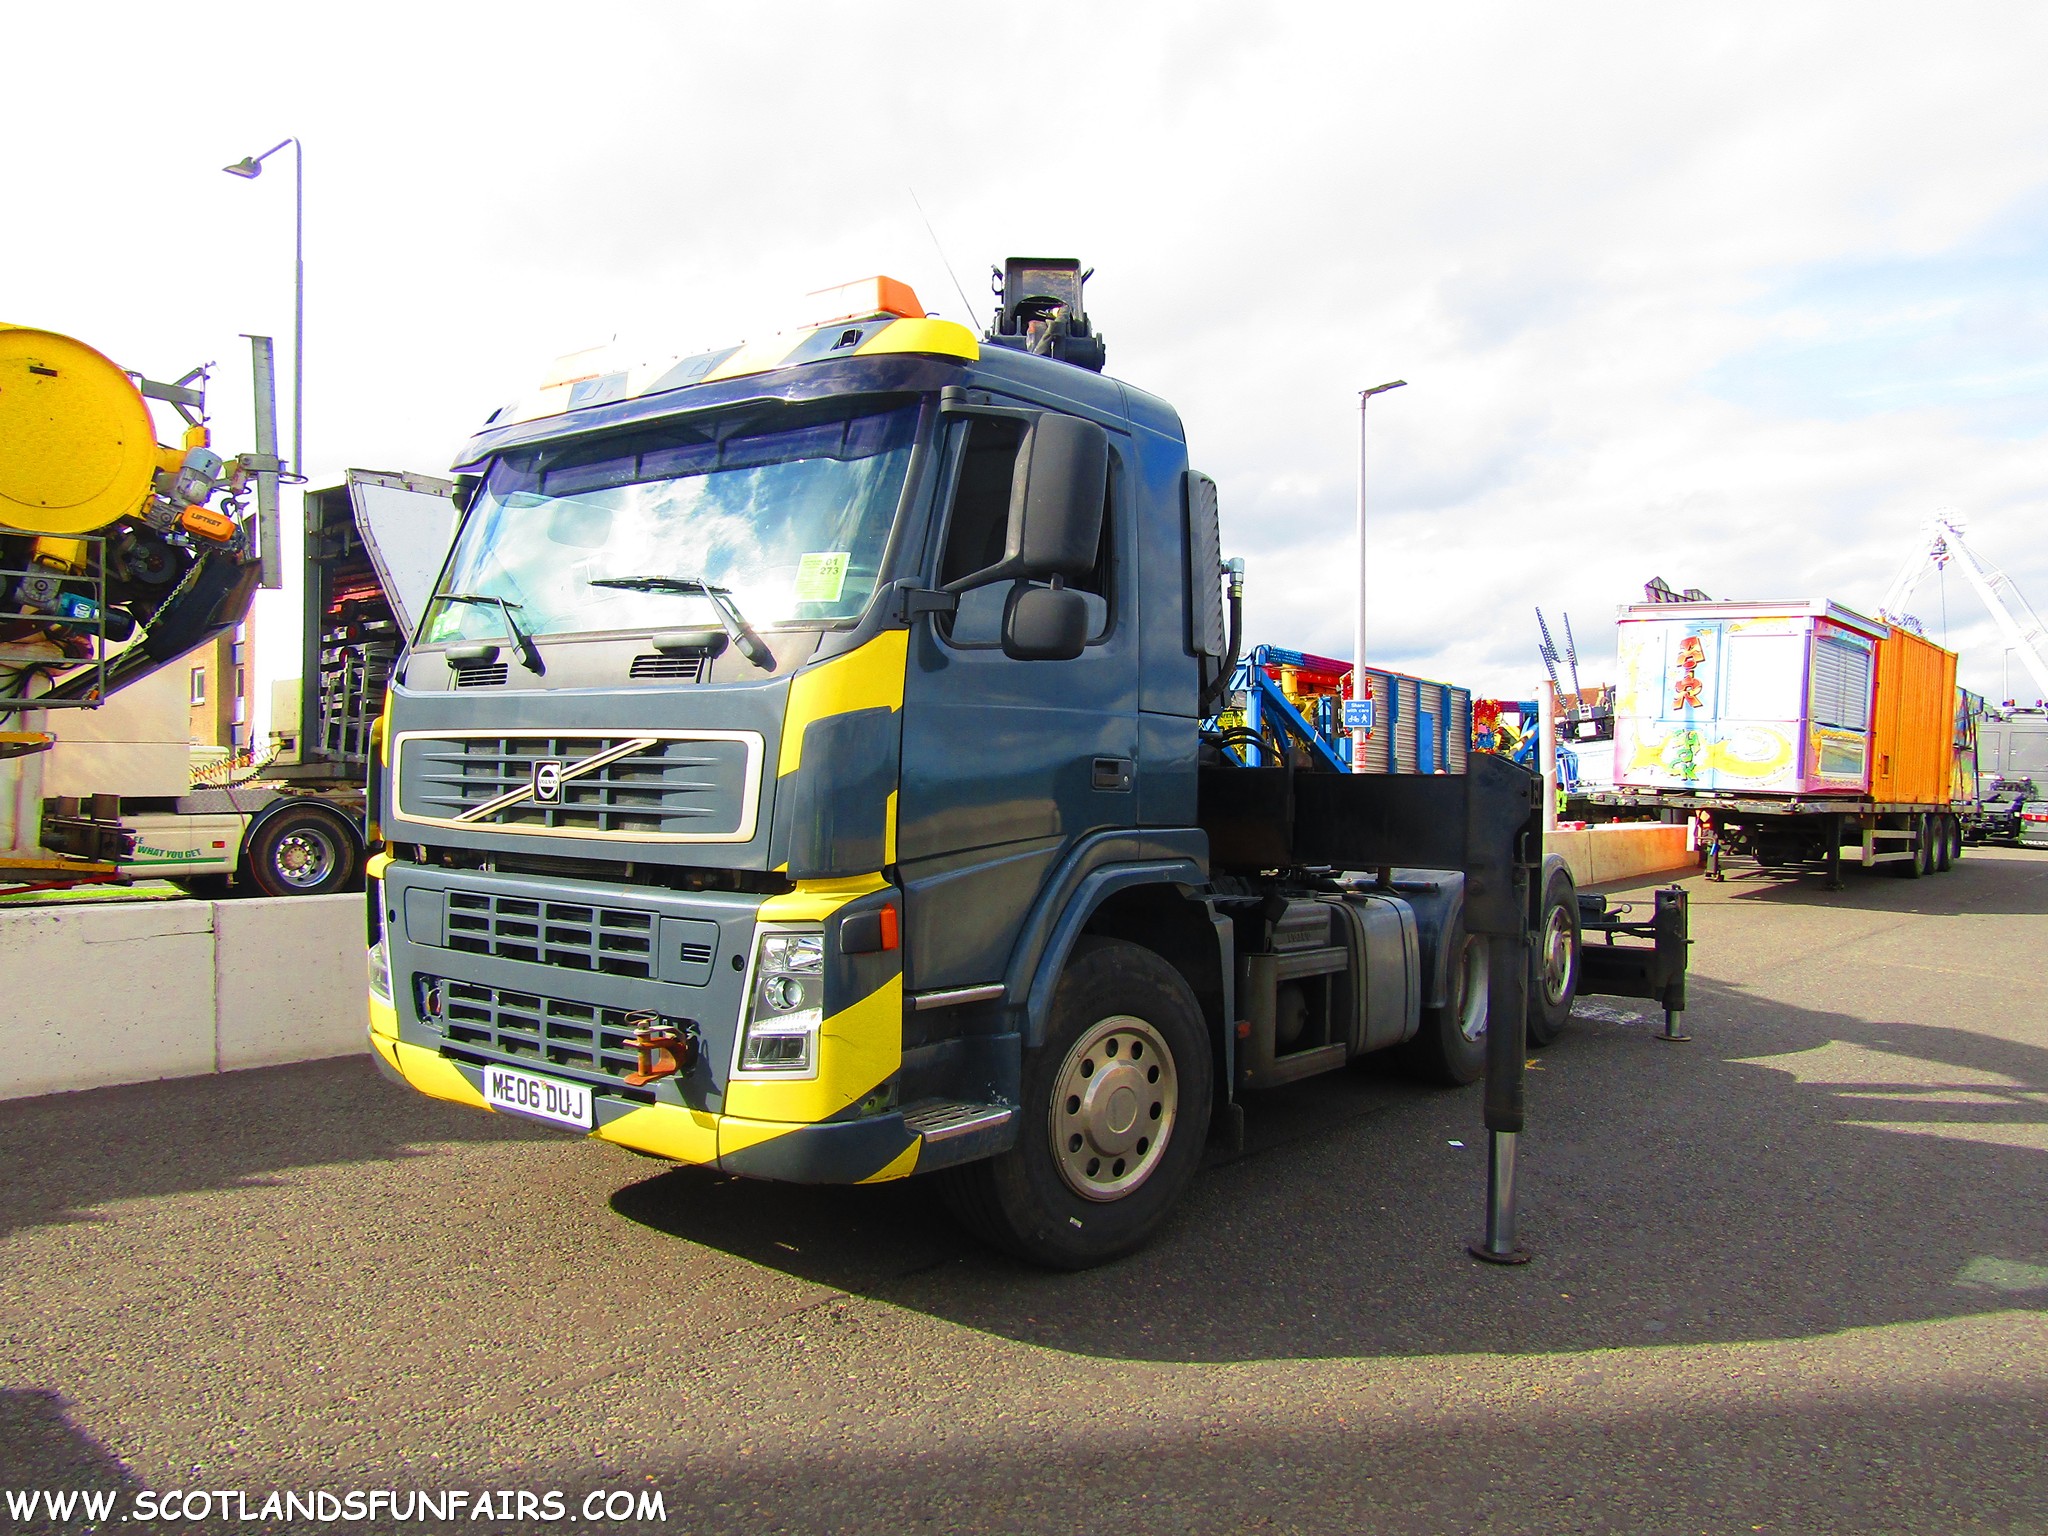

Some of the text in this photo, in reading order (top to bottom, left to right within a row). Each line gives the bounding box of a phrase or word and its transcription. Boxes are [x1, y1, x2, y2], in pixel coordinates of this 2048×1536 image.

[191, 512, 222, 527] LIFTKET
[819, 566, 839, 575] 273
[137, 845, 202, 859] WHAT YOU GET
[493, 1072, 583, 1119] ME06 DUJ
